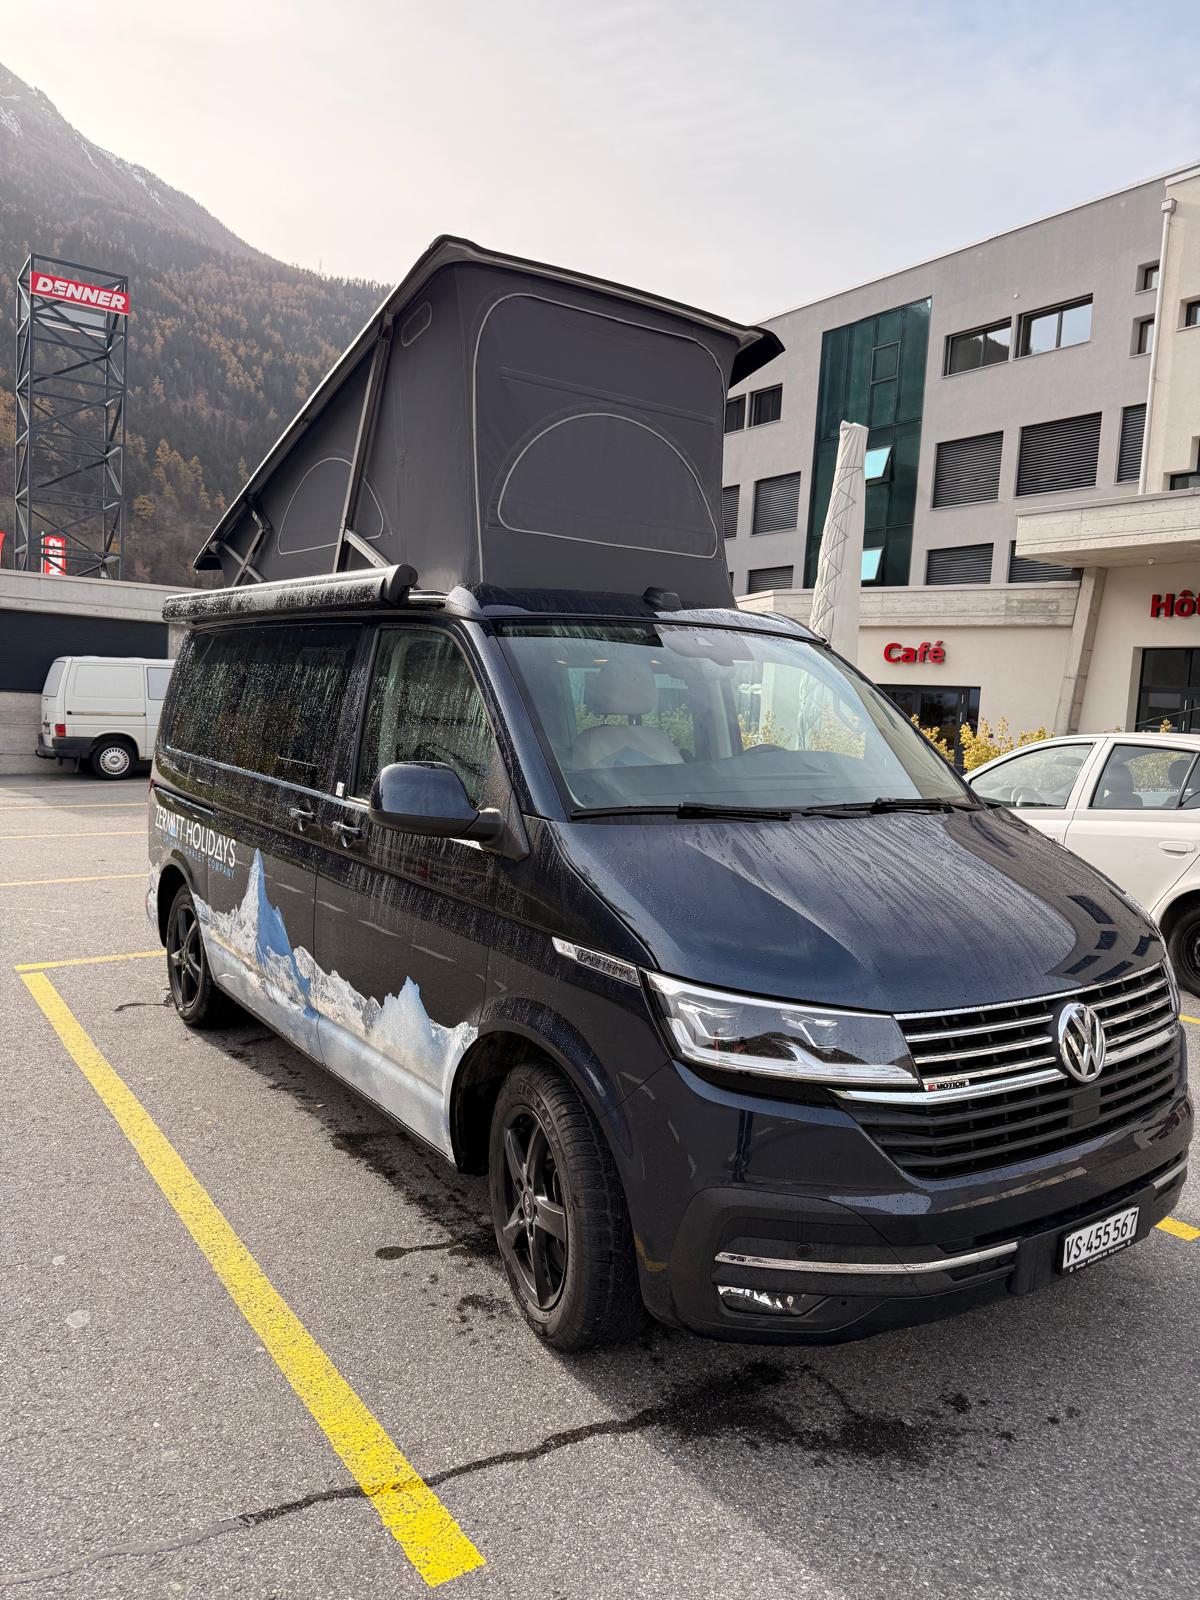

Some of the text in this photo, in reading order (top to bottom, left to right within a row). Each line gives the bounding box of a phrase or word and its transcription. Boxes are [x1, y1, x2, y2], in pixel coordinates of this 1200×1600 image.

[36, 276, 126, 310] DENNER
[883, 640, 946, 664] Café
[186, 818, 237, 868] HOLIDAYS
[207, 857, 235, 879] COMPANY
